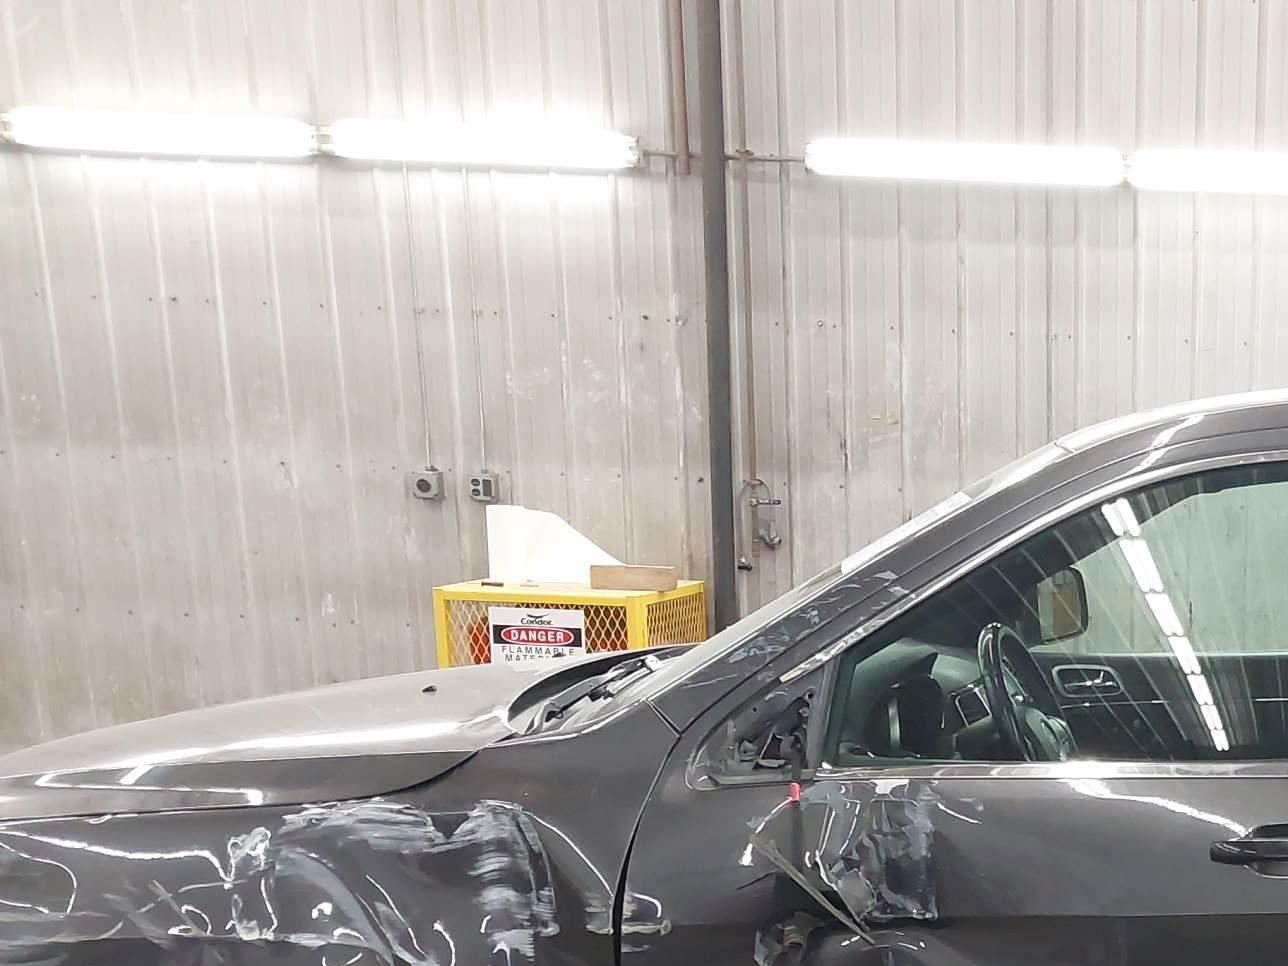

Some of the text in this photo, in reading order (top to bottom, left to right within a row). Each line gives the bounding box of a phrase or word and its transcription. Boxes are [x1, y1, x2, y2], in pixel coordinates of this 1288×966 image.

[520, 617, 552, 626] Condor
[510, 629, 564, 642] DANGER
[501, 645, 575, 656] FLAMMABLE
